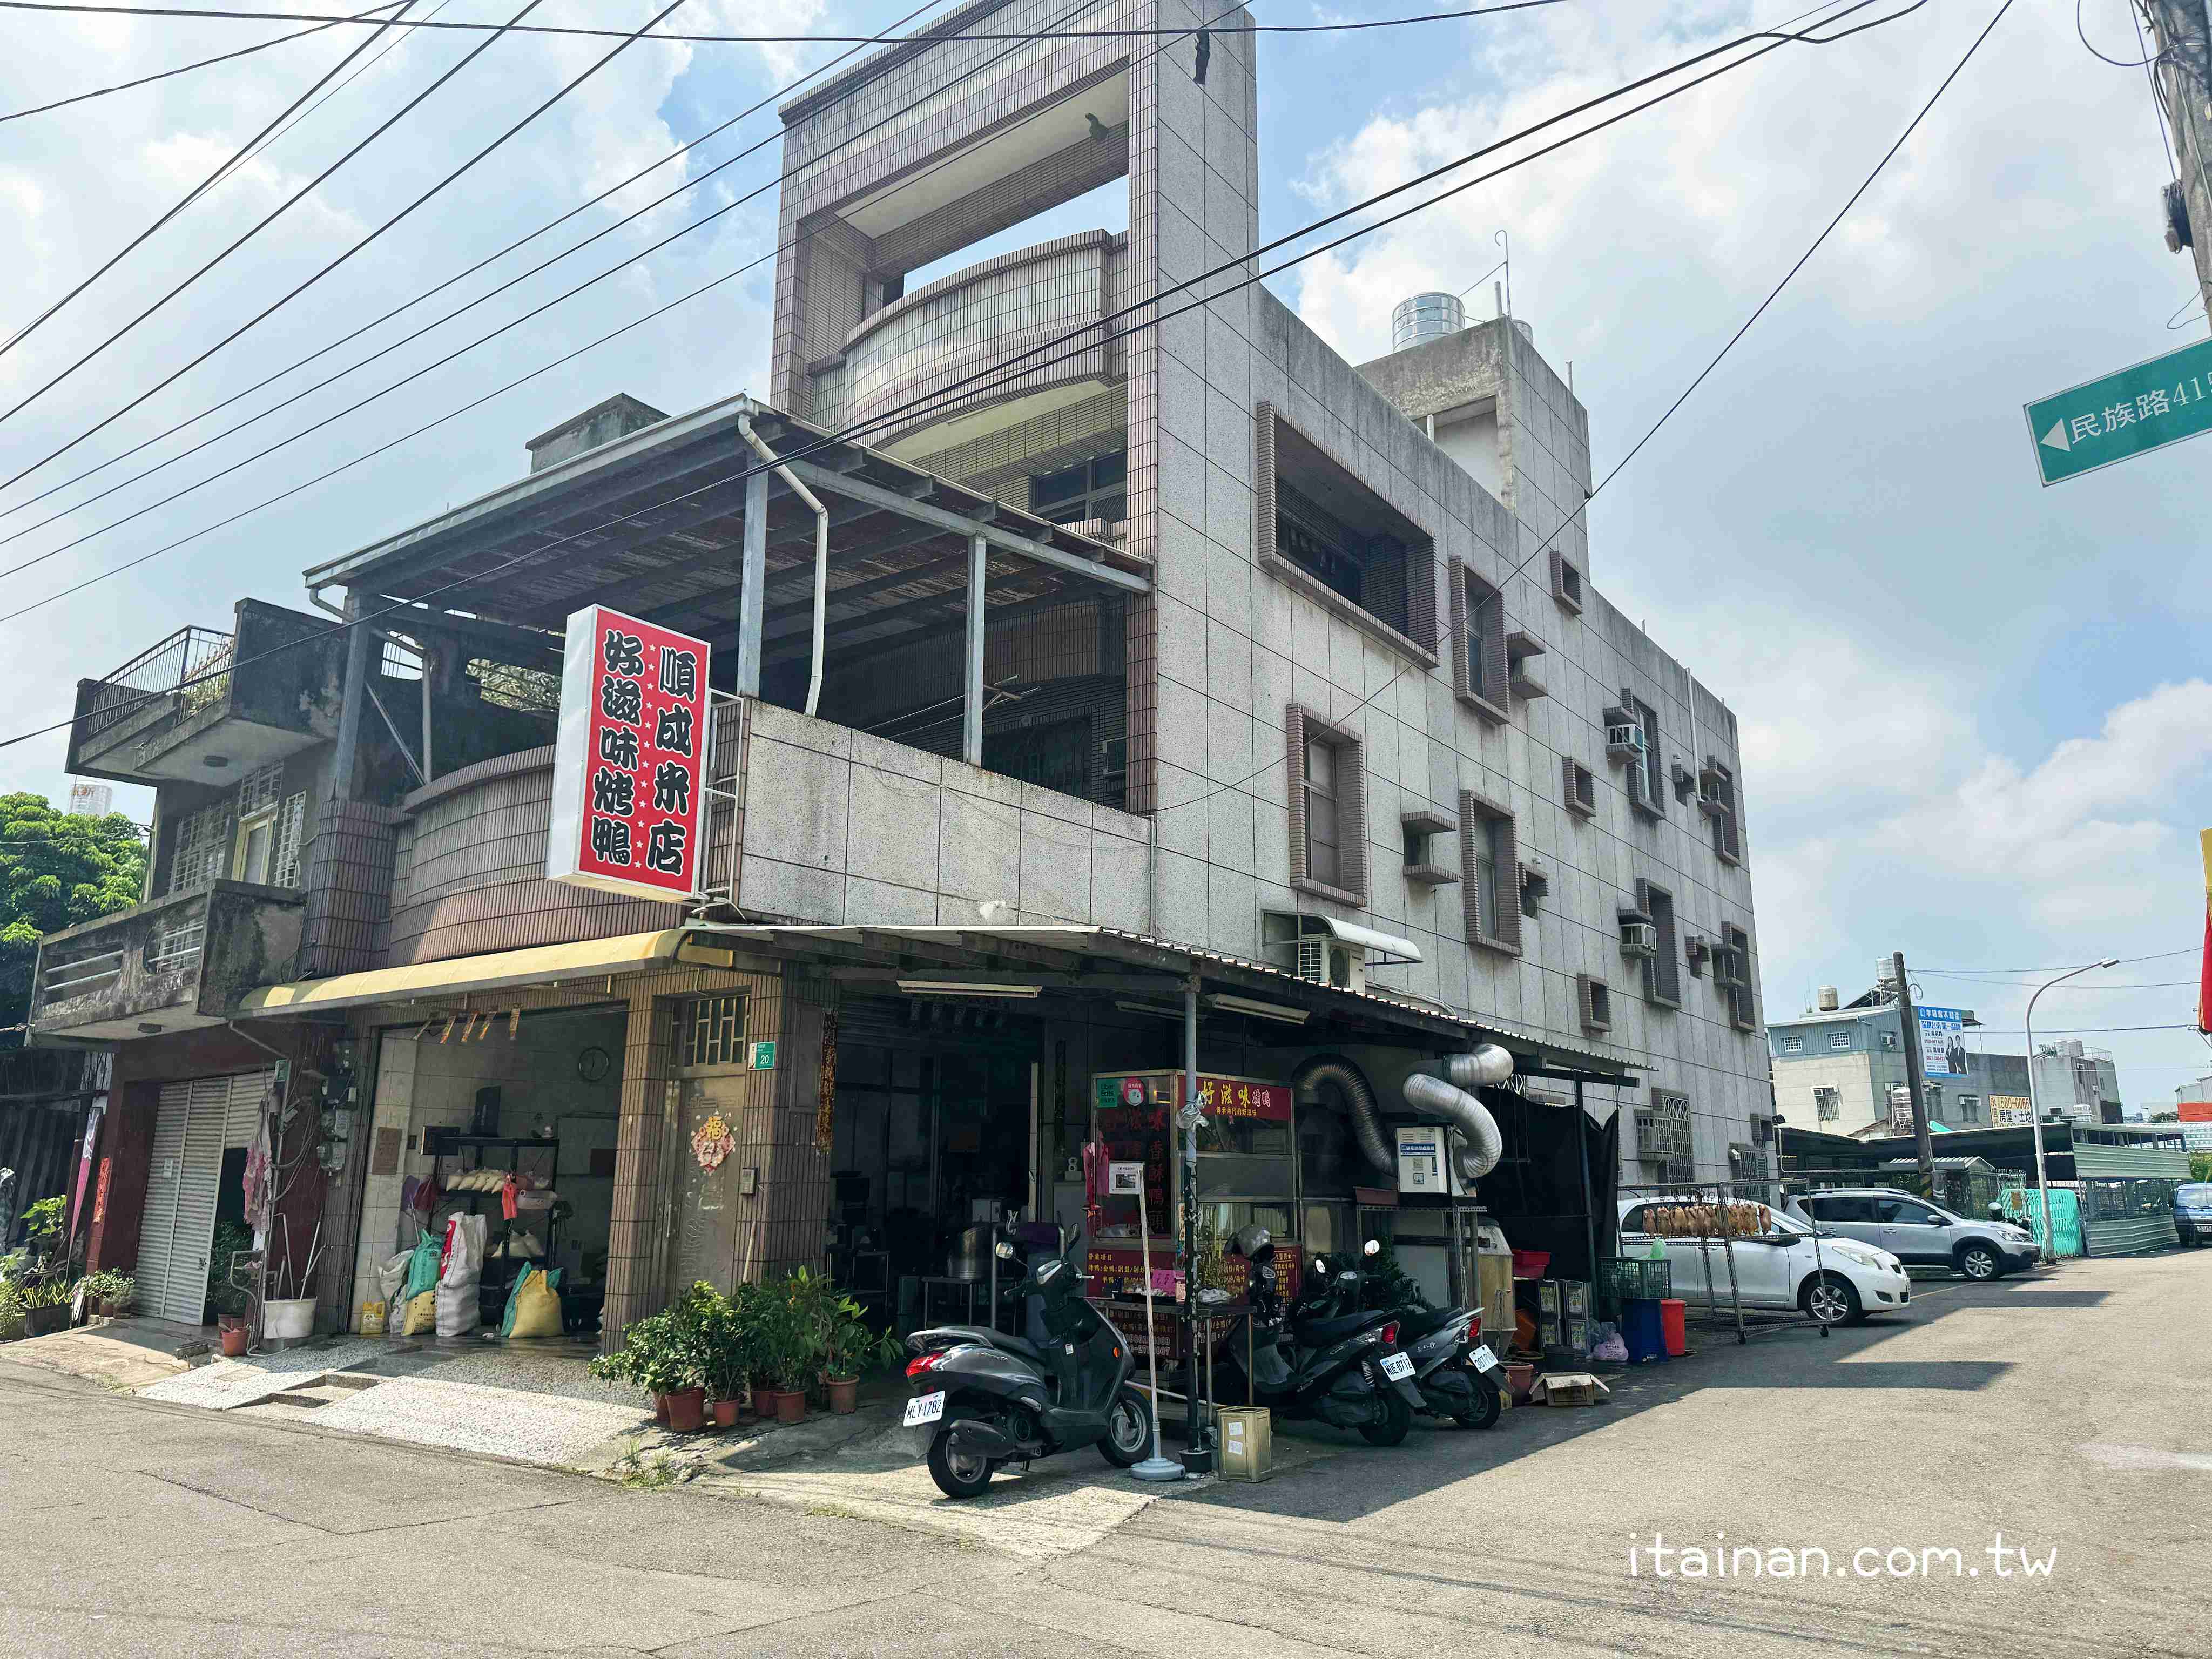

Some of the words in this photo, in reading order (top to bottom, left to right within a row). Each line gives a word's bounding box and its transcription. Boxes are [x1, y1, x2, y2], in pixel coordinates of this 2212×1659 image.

[590, 629, 645, 866] 好滋味烤鴨
[646, 645, 698, 876] 順成米店
[760, 1054, 770, 1064] 20
[2000, 1097, 2031, 1109] 580-0066
